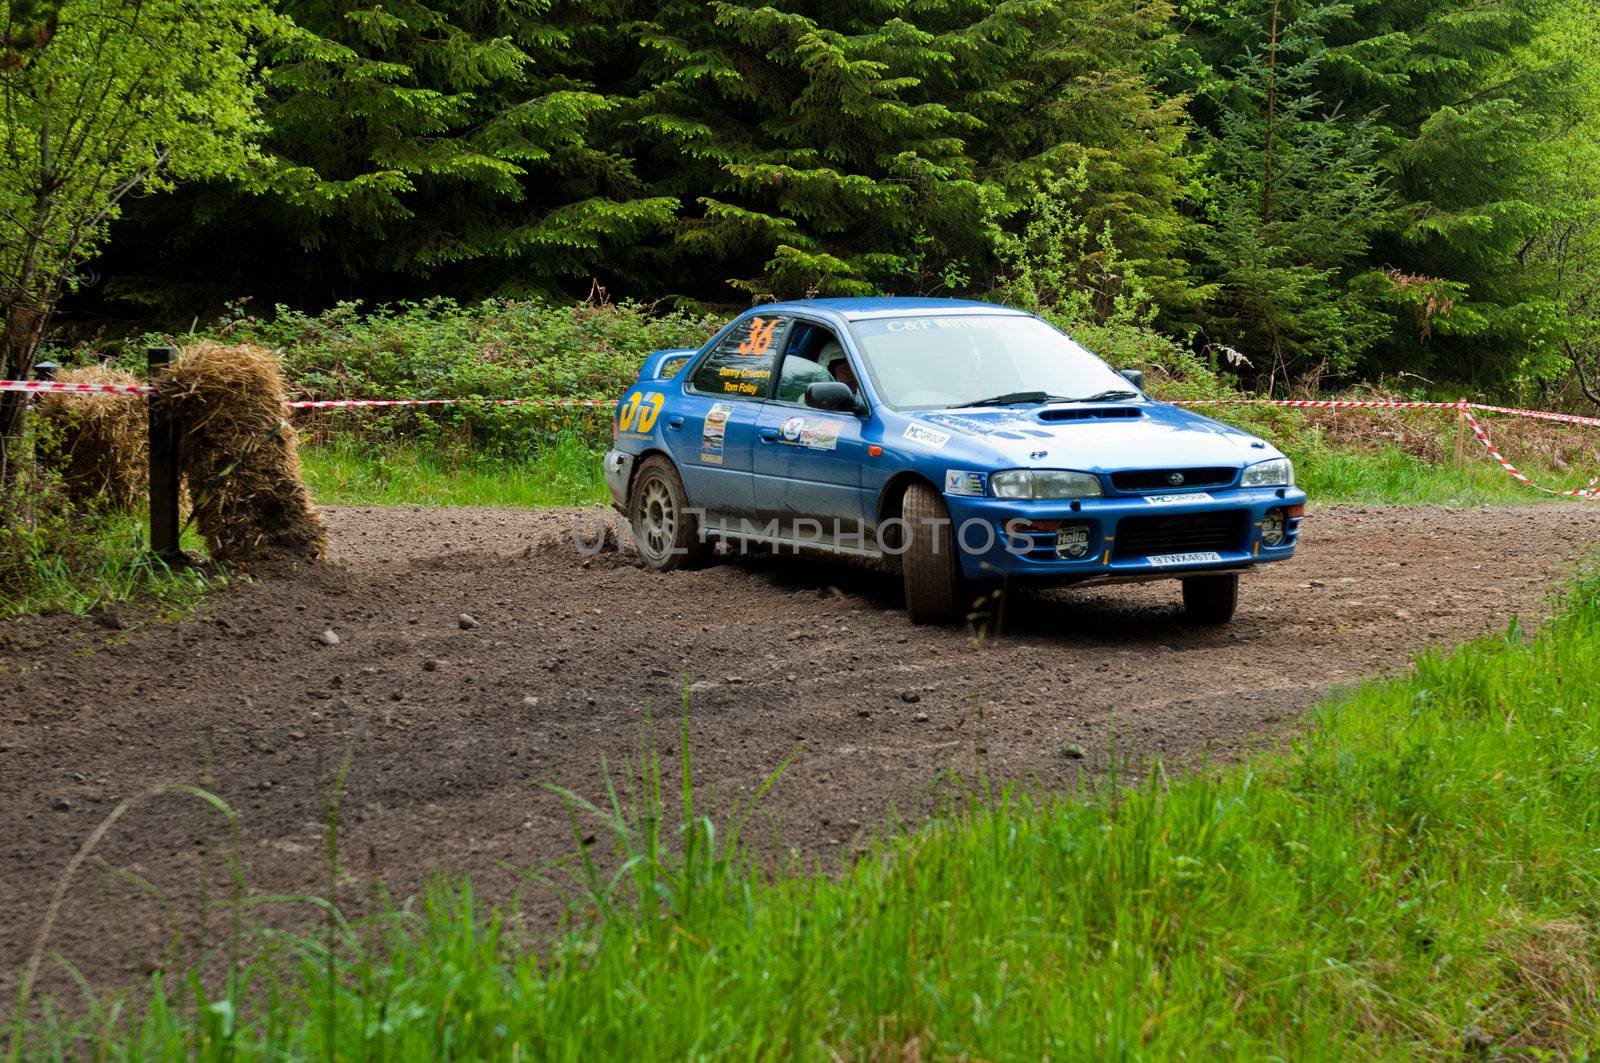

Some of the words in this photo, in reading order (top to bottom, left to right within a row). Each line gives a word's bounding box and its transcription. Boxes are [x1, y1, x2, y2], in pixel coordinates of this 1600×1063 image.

[886, 319, 931, 332] C&F
[739, 318, 779, 356] 36
[724, 381, 738, 391] Tom
[738, 382, 758, 395] Foley
[1057, 532, 1087, 545] Hella
[1153, 552, 1217, 564] 97WX4672
